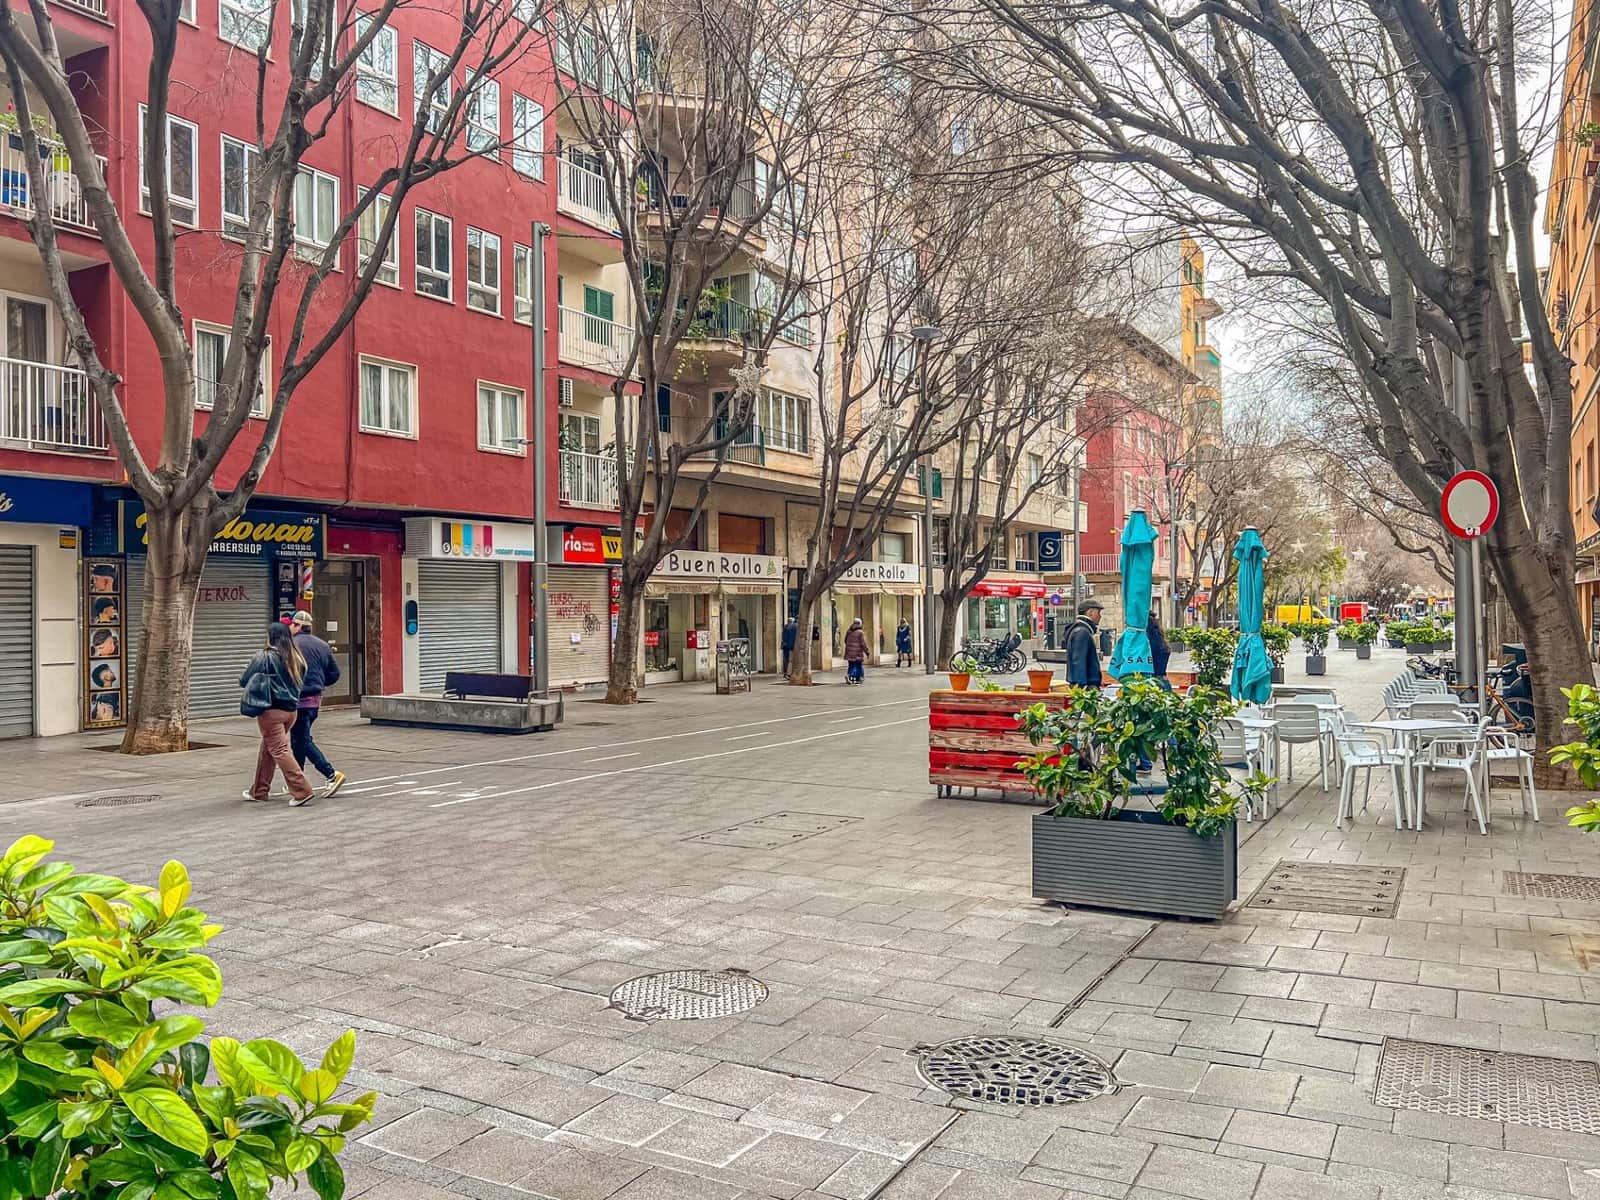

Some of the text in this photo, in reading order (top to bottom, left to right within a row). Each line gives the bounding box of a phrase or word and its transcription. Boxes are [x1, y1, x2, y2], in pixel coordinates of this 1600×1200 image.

[207, 542, 262, 554] ARBERSHOP
[564, 534, 582, 552] ria
[669, 553, 762, 574] Buen Rollo
[846, 565, 905, 579] Buen Rollo
